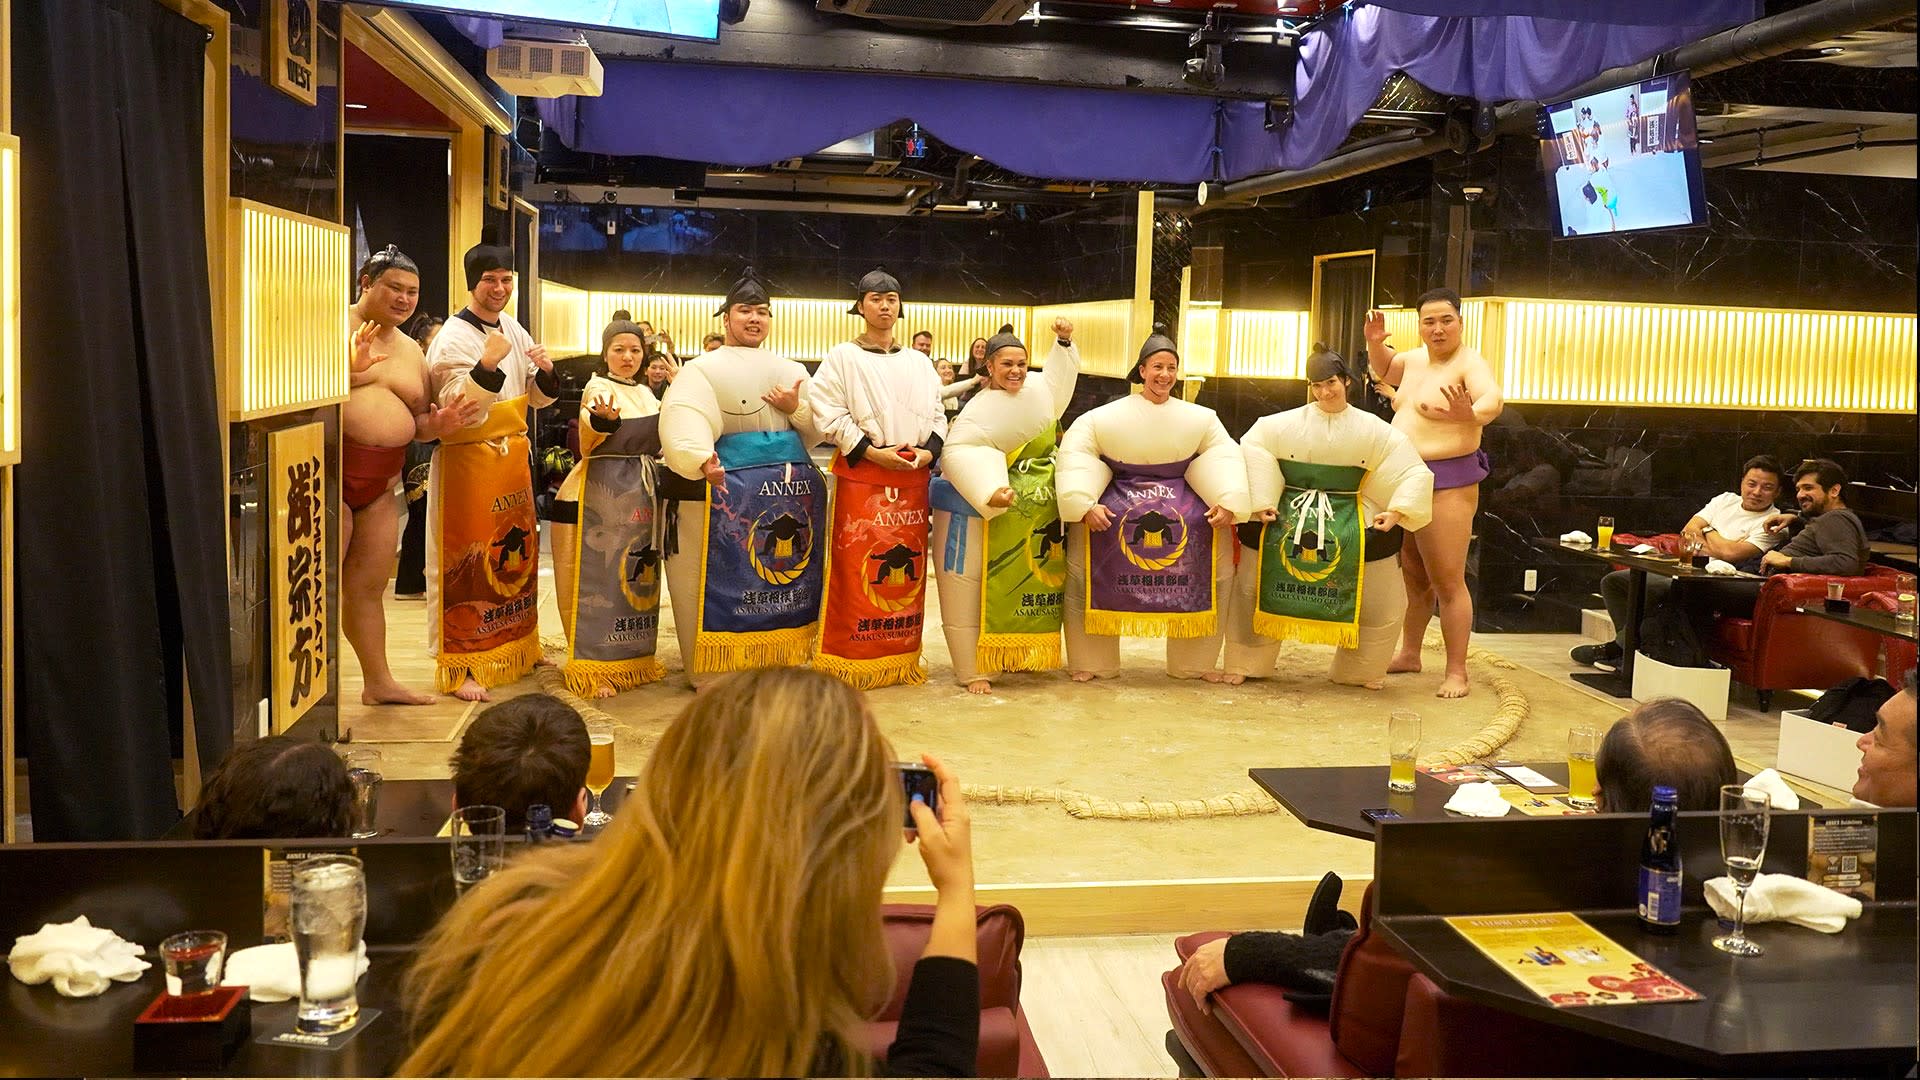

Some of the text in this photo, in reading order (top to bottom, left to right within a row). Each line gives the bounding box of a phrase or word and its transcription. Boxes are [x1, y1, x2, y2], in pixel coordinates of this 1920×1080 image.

[287, 57, 312, 92] WEST
[758, 479, 812, 496] ANNEX
[1127, 485, 1176, 499] ANNEX
[871, 509, 925, 526] ANNEX
[312, 455, 323, 678] ASAMUNAKATA
[1012, 607, 1050, 617] ASAKUSA
[848, 632, 886, 641] ASAKUSA
[887, 628, 909, 639] SUMO
